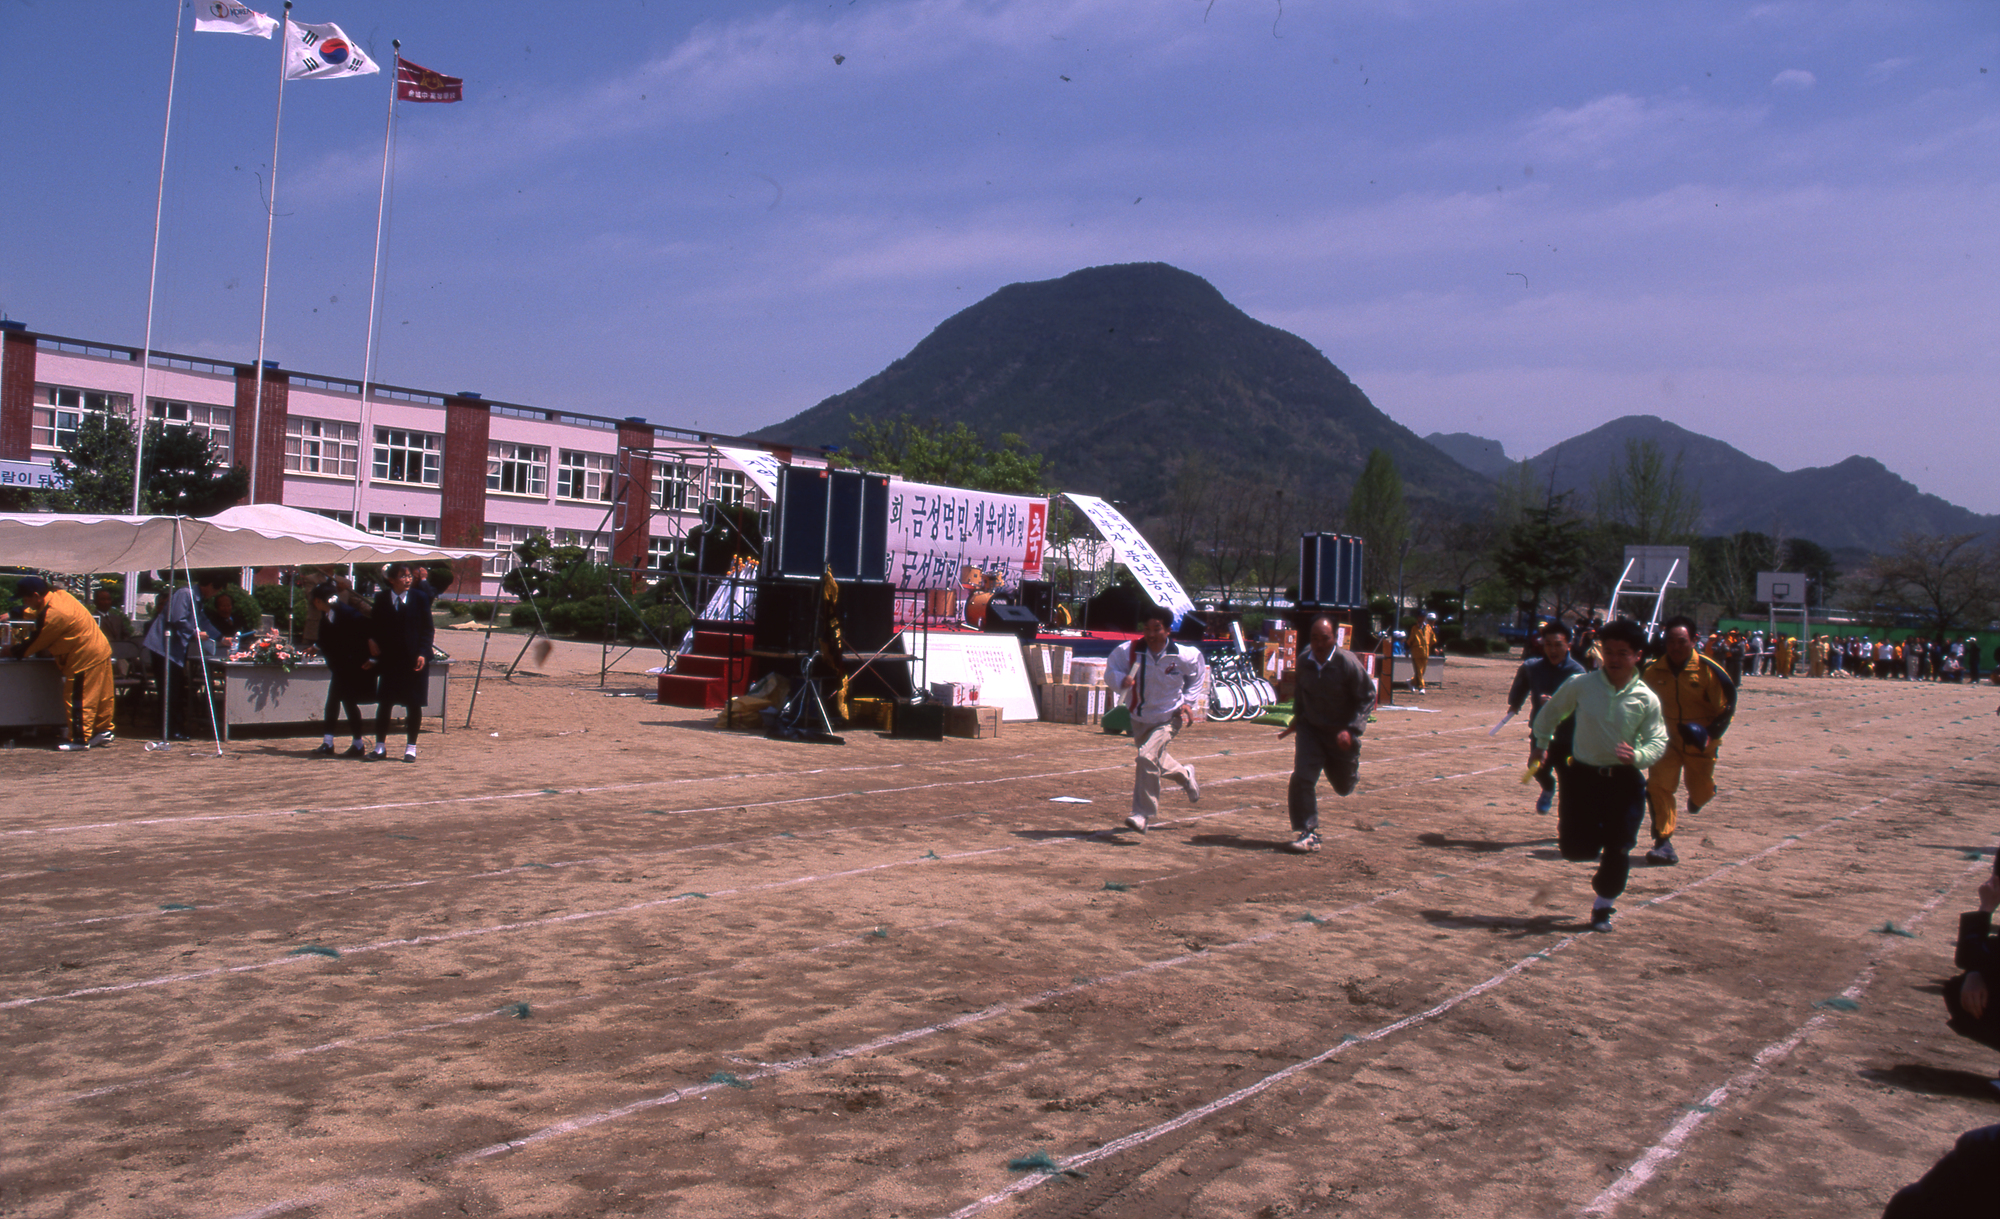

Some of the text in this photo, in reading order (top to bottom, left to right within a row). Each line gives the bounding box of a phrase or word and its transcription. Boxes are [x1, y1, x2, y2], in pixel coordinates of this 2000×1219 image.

[1, 471, 32, 485] 람이
[889, 494, 904, 534] 회
[1124, 550, 1174, 606] 풍년농사
